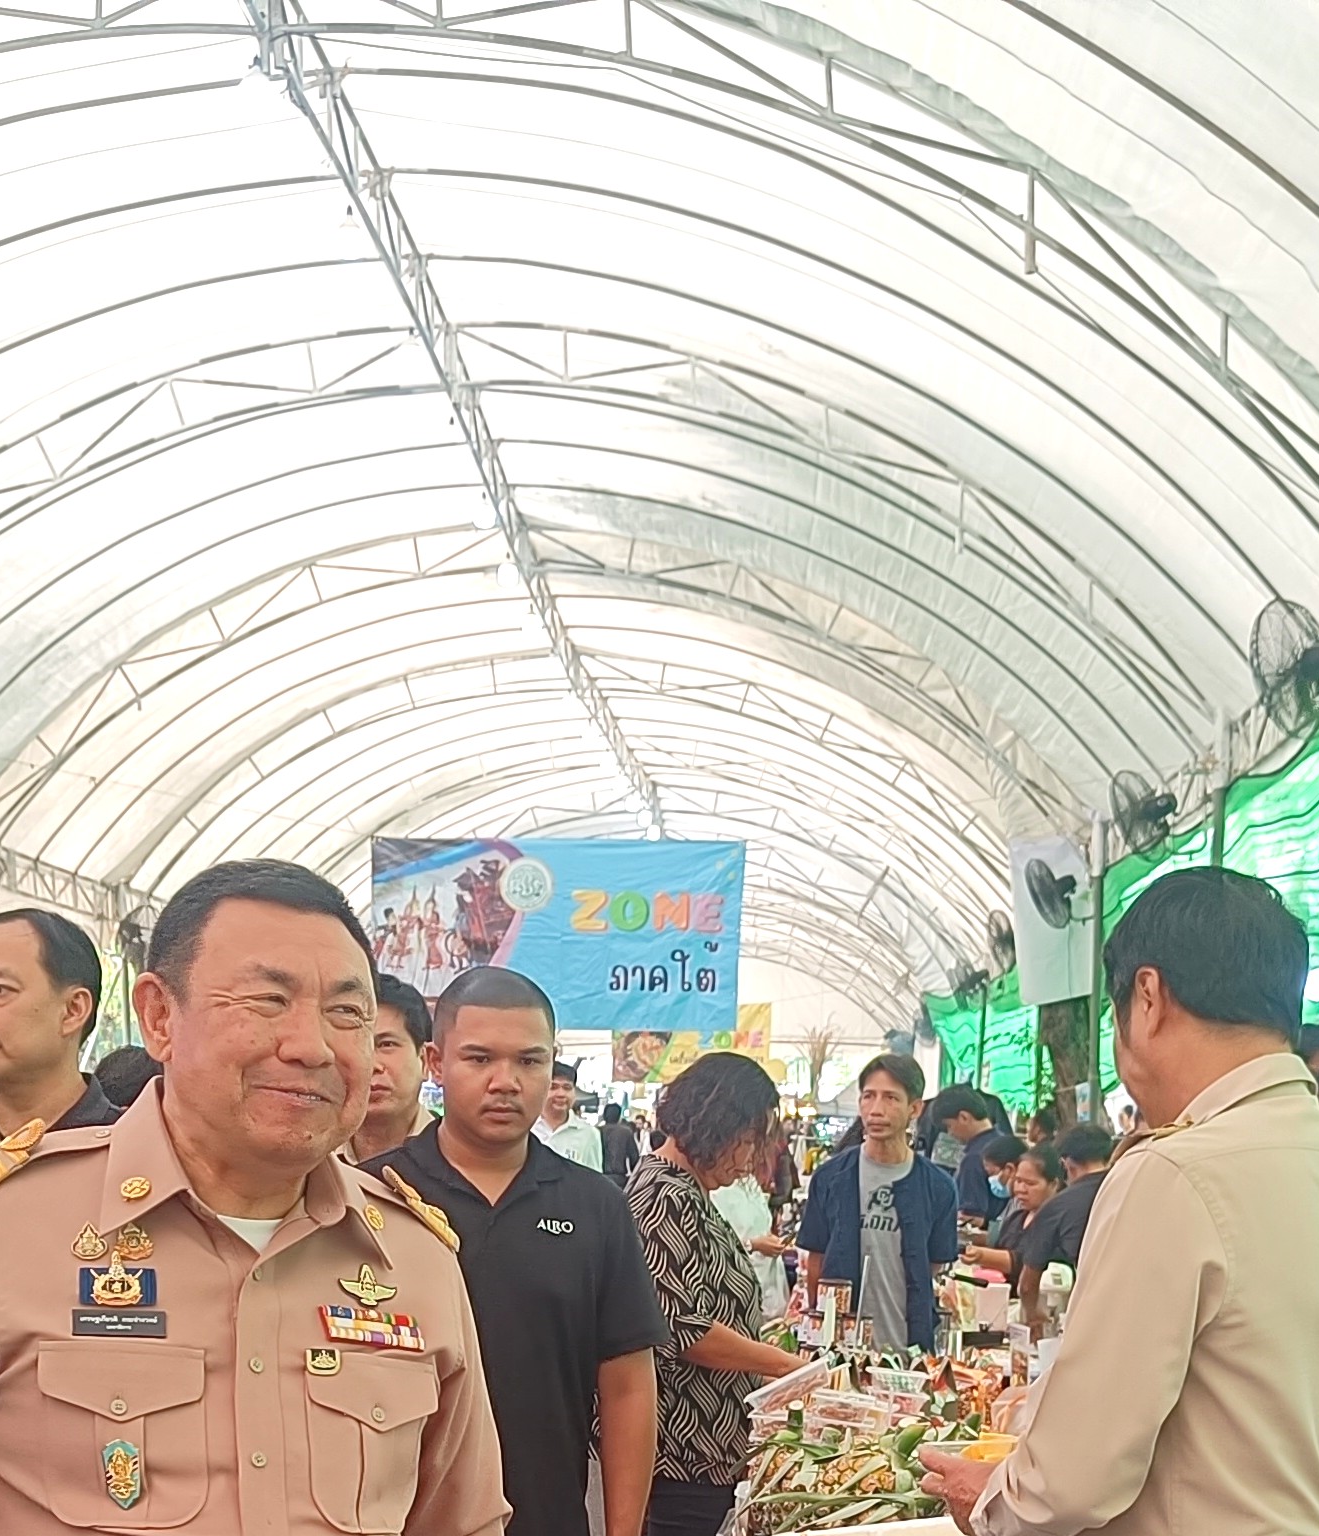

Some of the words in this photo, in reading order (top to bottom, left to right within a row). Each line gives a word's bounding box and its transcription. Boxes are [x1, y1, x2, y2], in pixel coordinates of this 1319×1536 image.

[569, 889, 726, 933] ZONE
[608, 941, 717, 993] ภาคใต้
[697, 1030, 764, 1049] ZONE
[536, 1218, 574, 1235] ALRO
